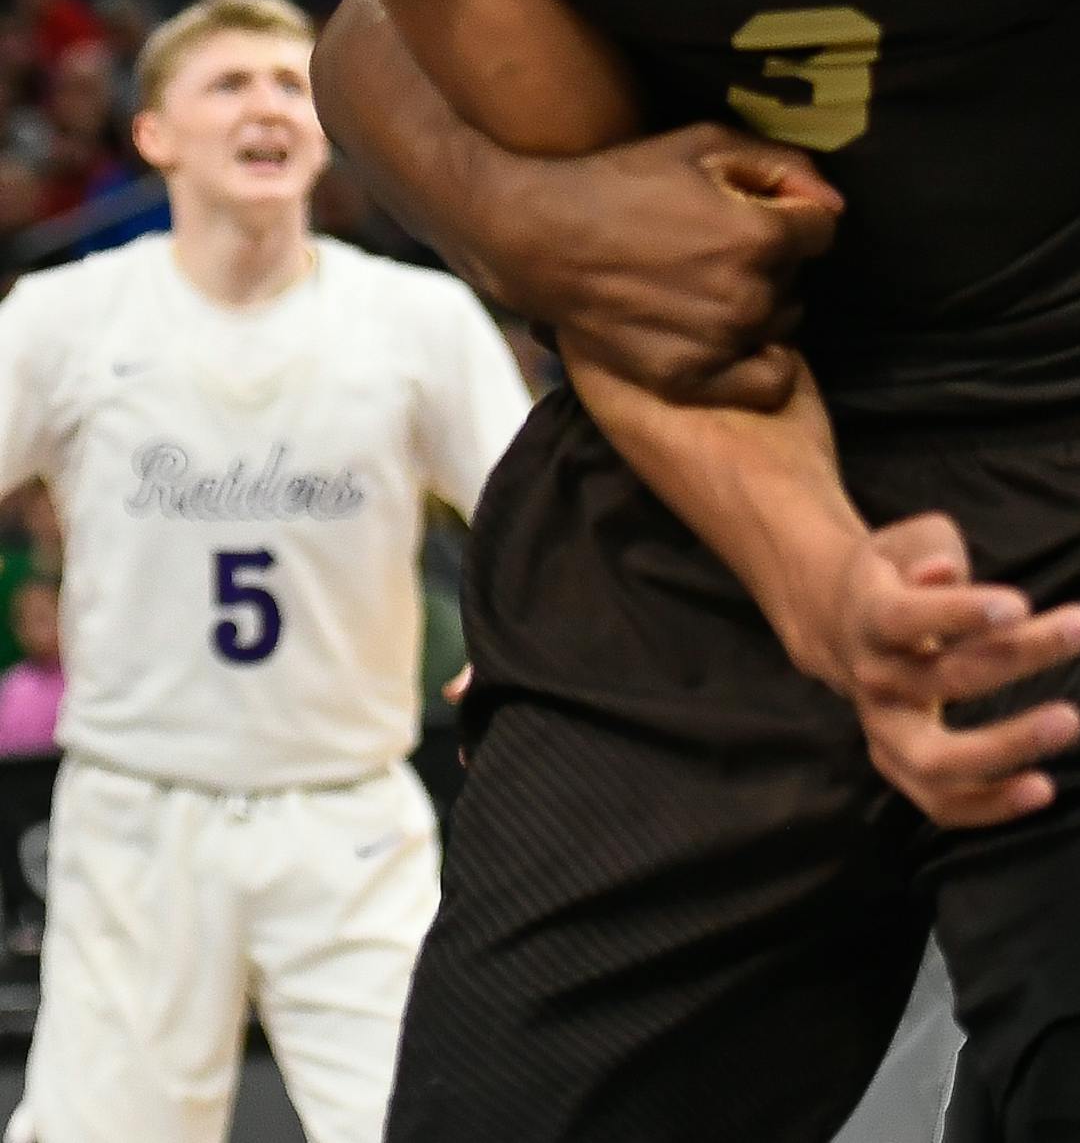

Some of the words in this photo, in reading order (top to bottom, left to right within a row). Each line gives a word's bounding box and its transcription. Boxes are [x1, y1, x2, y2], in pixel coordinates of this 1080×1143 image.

[728, 6, 881, 152] 3
[124, 440, 367, 521] Raiders
[212, 550, 281, 663] 5
